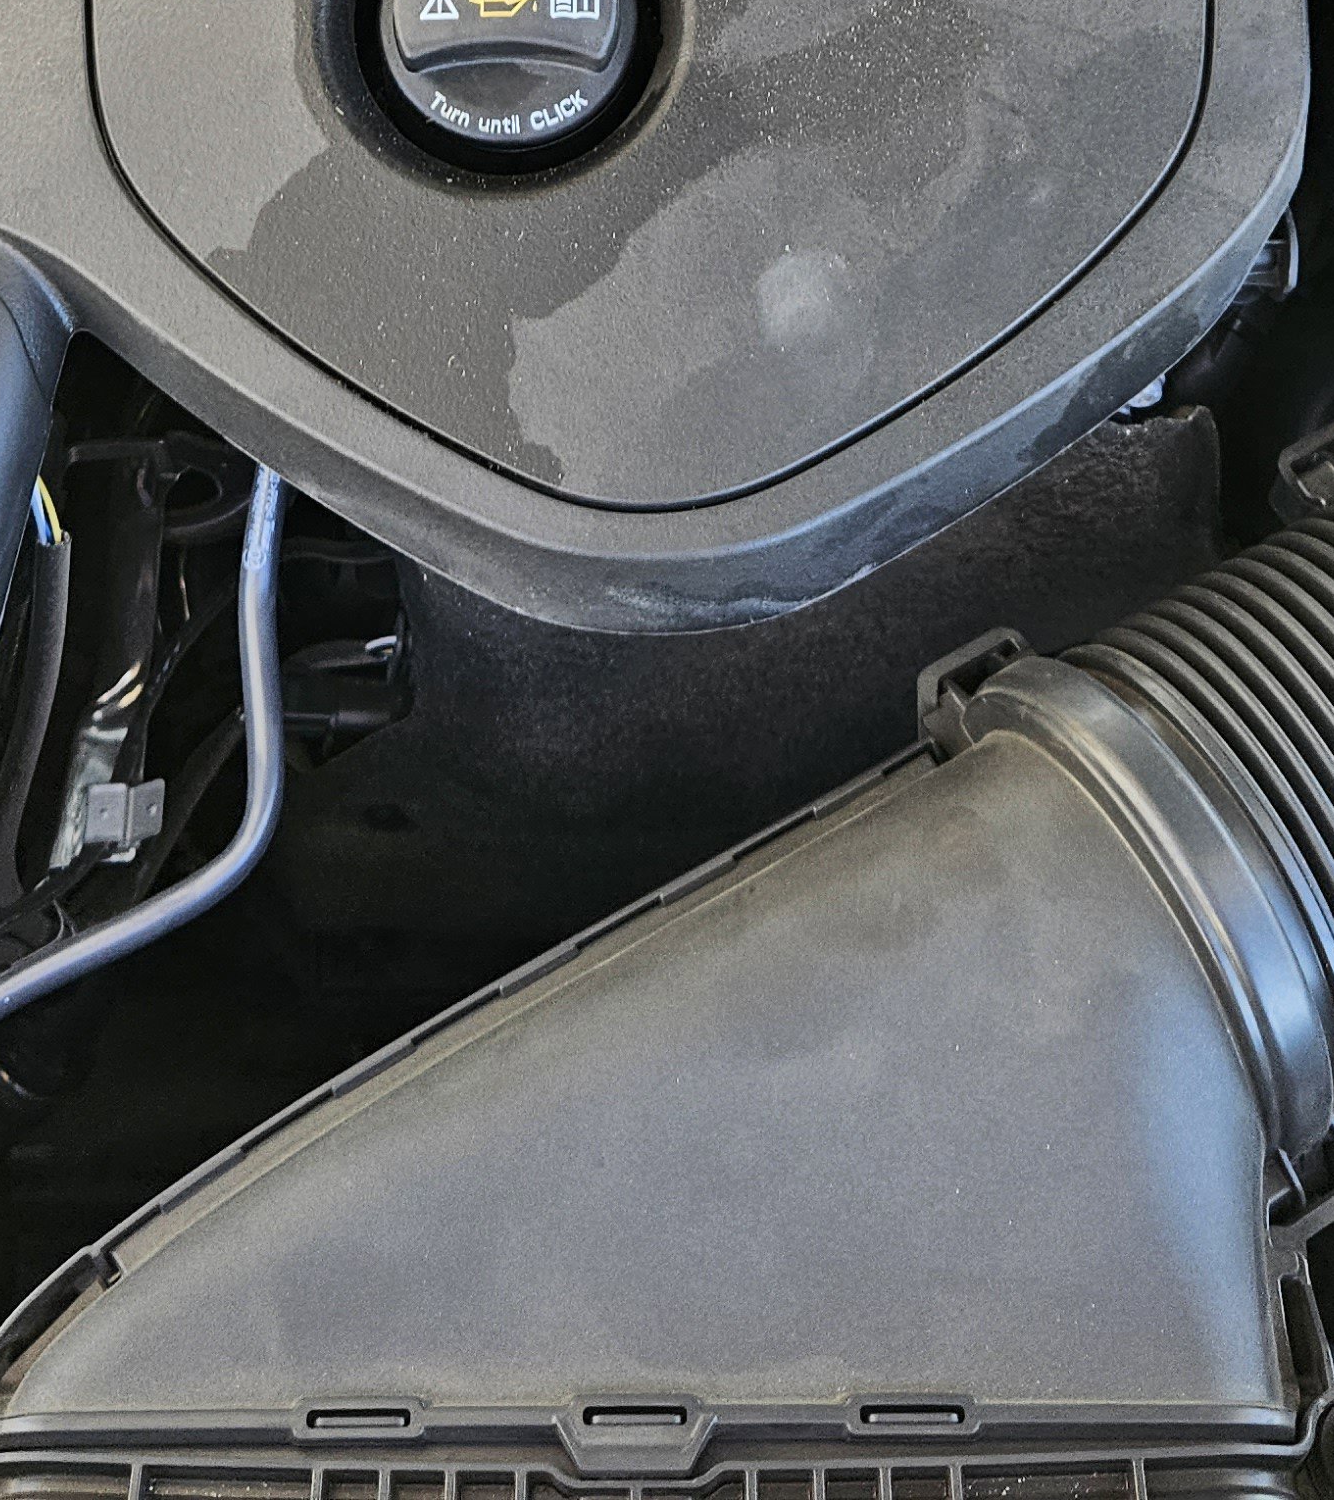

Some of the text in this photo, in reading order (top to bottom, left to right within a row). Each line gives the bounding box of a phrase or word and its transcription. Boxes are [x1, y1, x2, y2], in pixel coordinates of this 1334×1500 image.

[430, 89, 589, 134] Turn until CLICK
